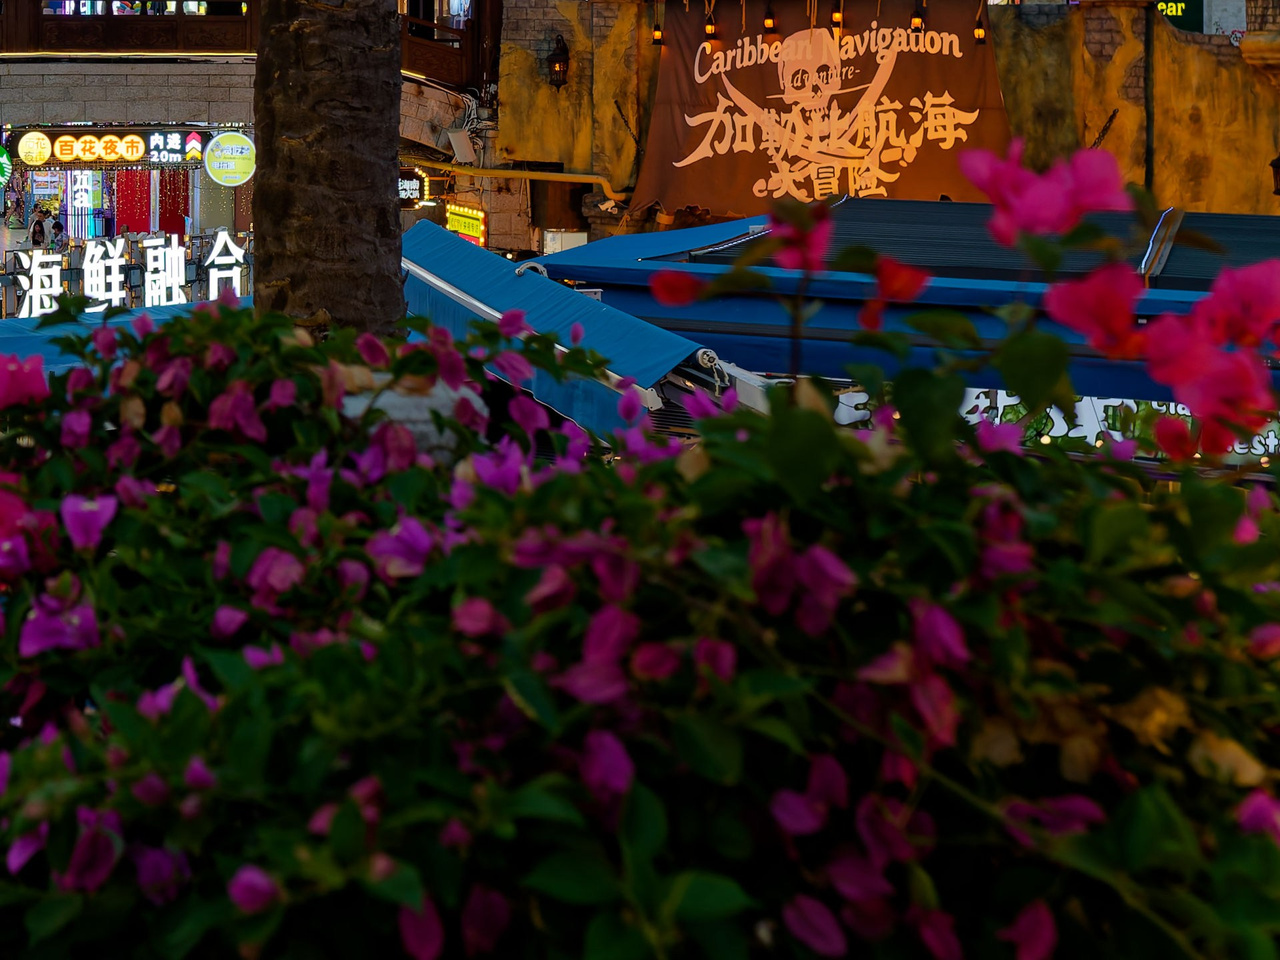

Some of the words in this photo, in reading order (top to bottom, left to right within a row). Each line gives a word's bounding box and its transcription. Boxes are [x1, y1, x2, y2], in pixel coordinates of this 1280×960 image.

[693, 33, 813, 84] Caribbean
[820, 20, 963, 64] Navigation
[58, 139, 140, 157] 百花夜市
[673, 90, 979, 167] 加勒比航海
[150, 150, 181, 162] 20m
[755, 159, 898, 203] 大冒险
